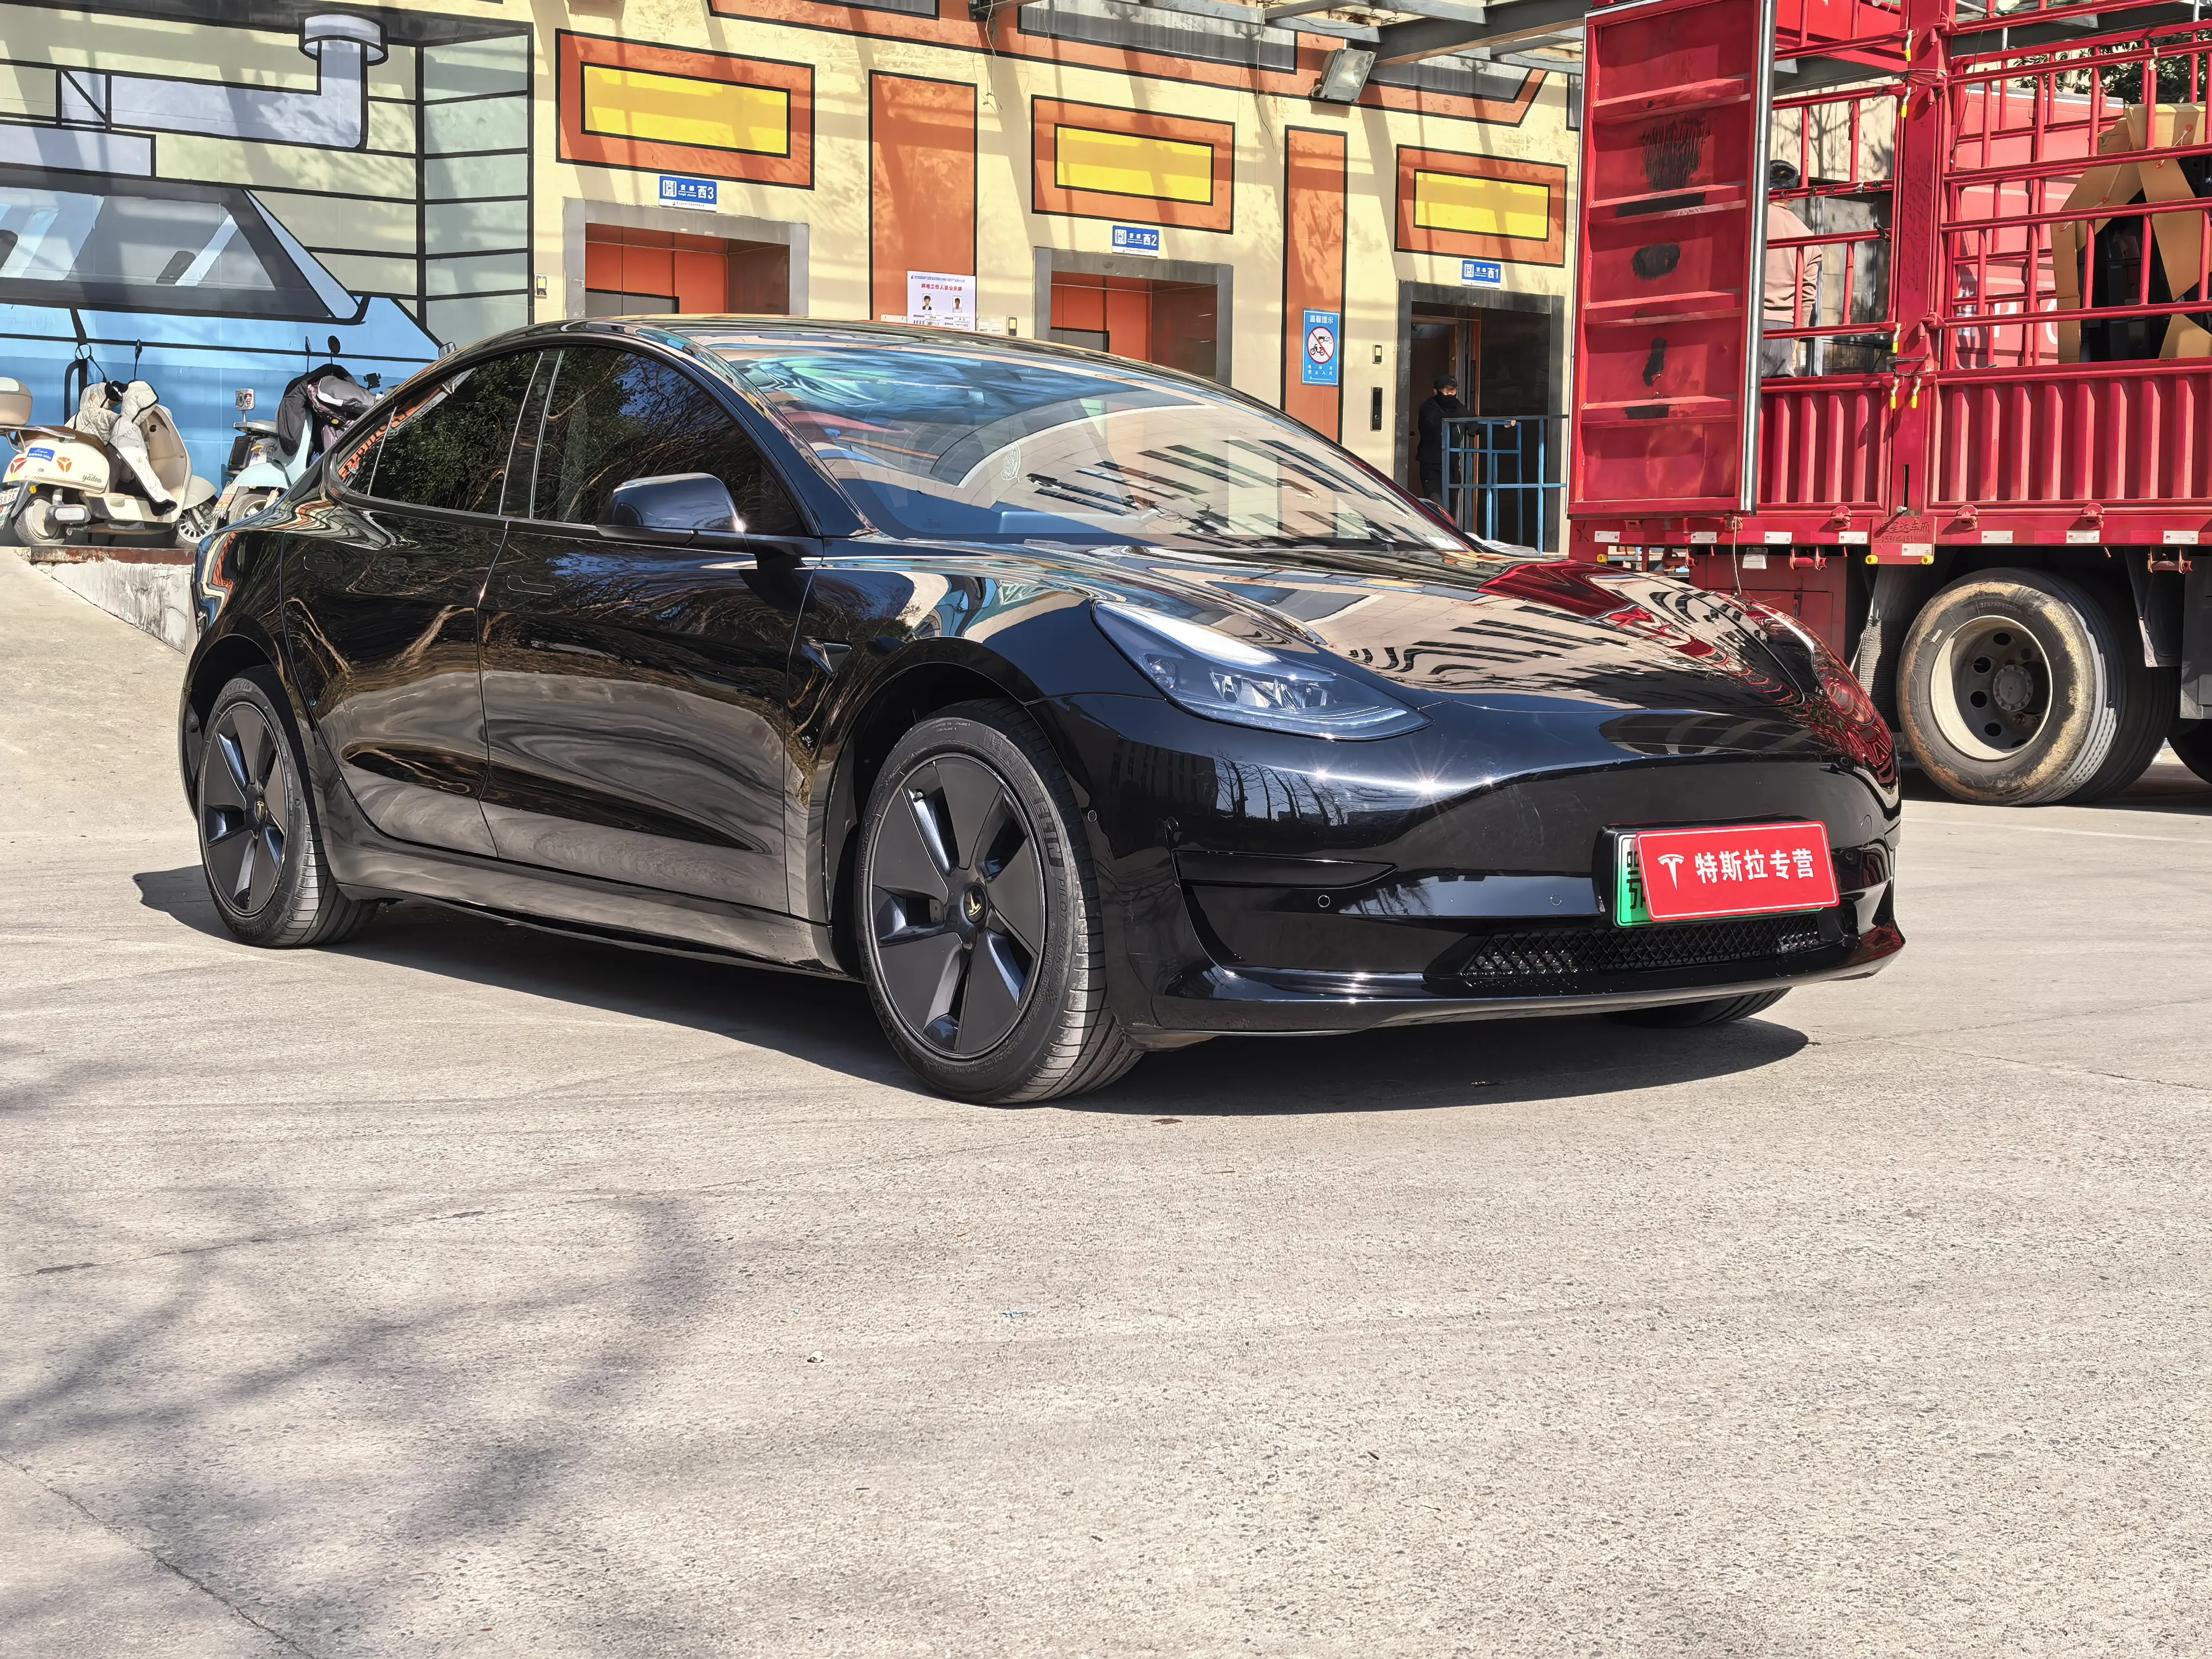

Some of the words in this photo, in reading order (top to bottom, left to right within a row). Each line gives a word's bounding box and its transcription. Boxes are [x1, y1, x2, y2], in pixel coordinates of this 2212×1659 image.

[697, 185, 714, 199] 西3
[1143, 233, 1157, 246] 西2
[1487, 267, 1499, 279] 西1
[1694, 848, 1815, 884] 特斯拉专营
[1057, 878, 1068, 922] PILOT
